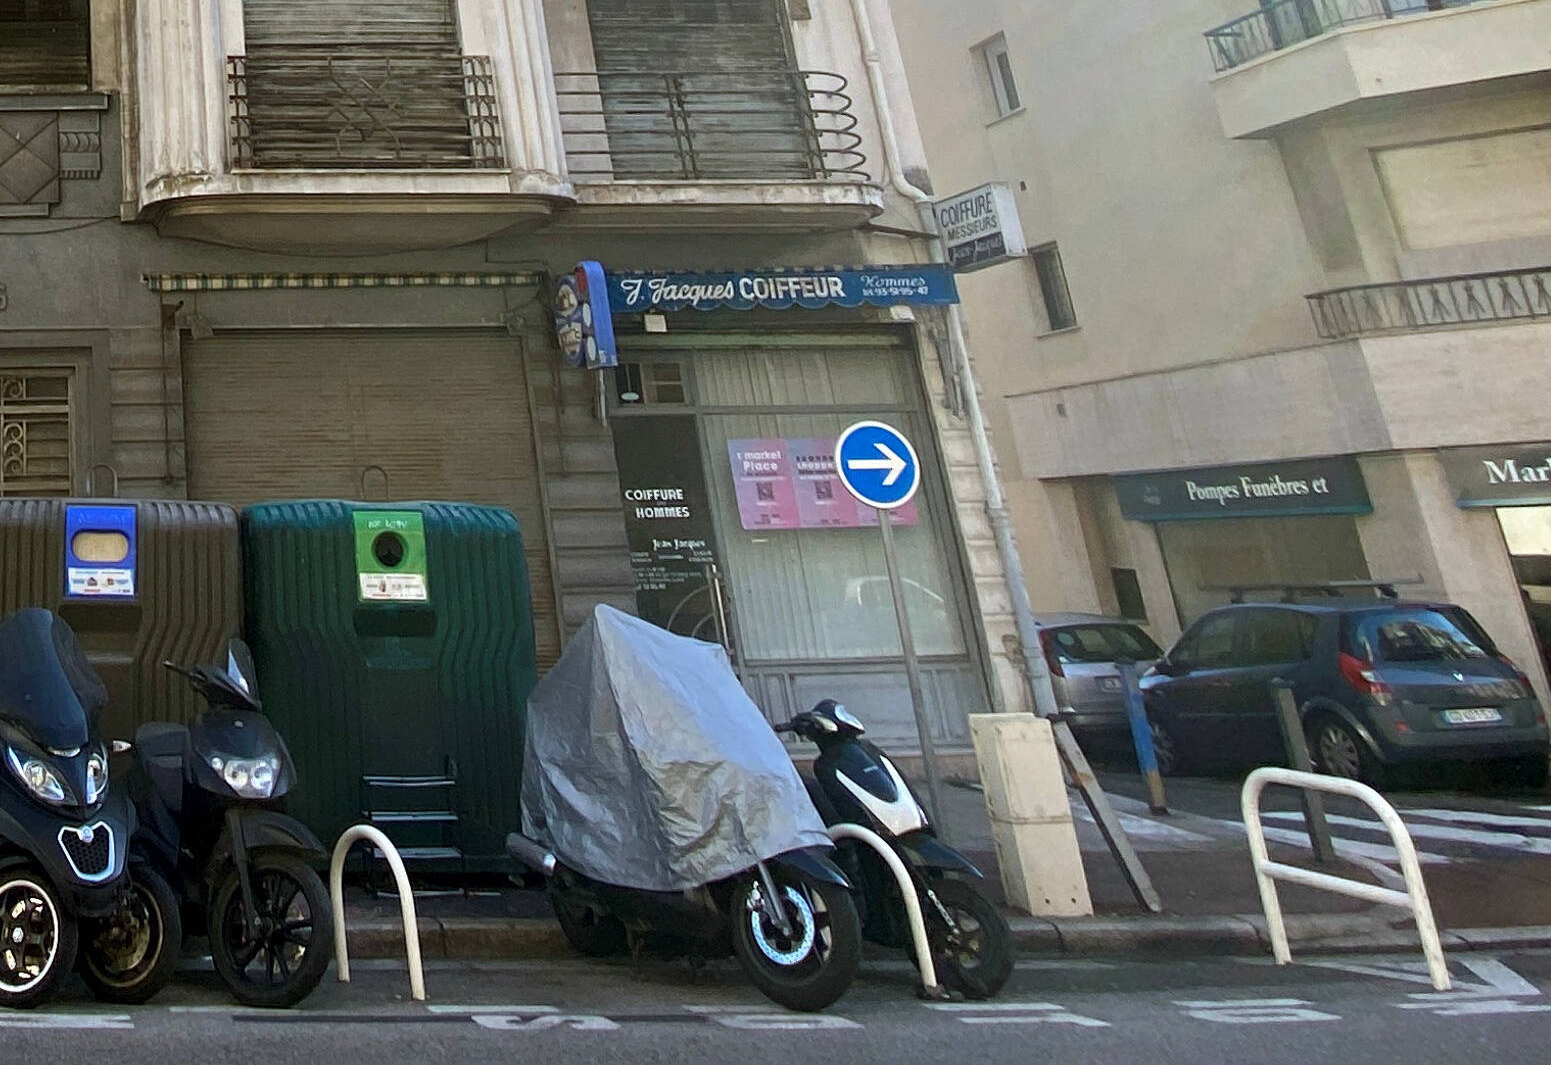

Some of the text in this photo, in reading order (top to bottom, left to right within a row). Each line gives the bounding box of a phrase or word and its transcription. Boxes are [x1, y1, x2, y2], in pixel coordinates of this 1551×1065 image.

[940, 191, 993, 228] COIFFURE
[620, 276, 847, 306] J. Jacques COIFFEUR
[860, 275, 926, 288] Hommes
[1482, 457, 1551, 484] Mar
[625, 488, 684, 501] COIFFURE
[1185, 474, 1329, 506] Pompes Funèbres et
[635, 506, 690, 519] HOMMES
